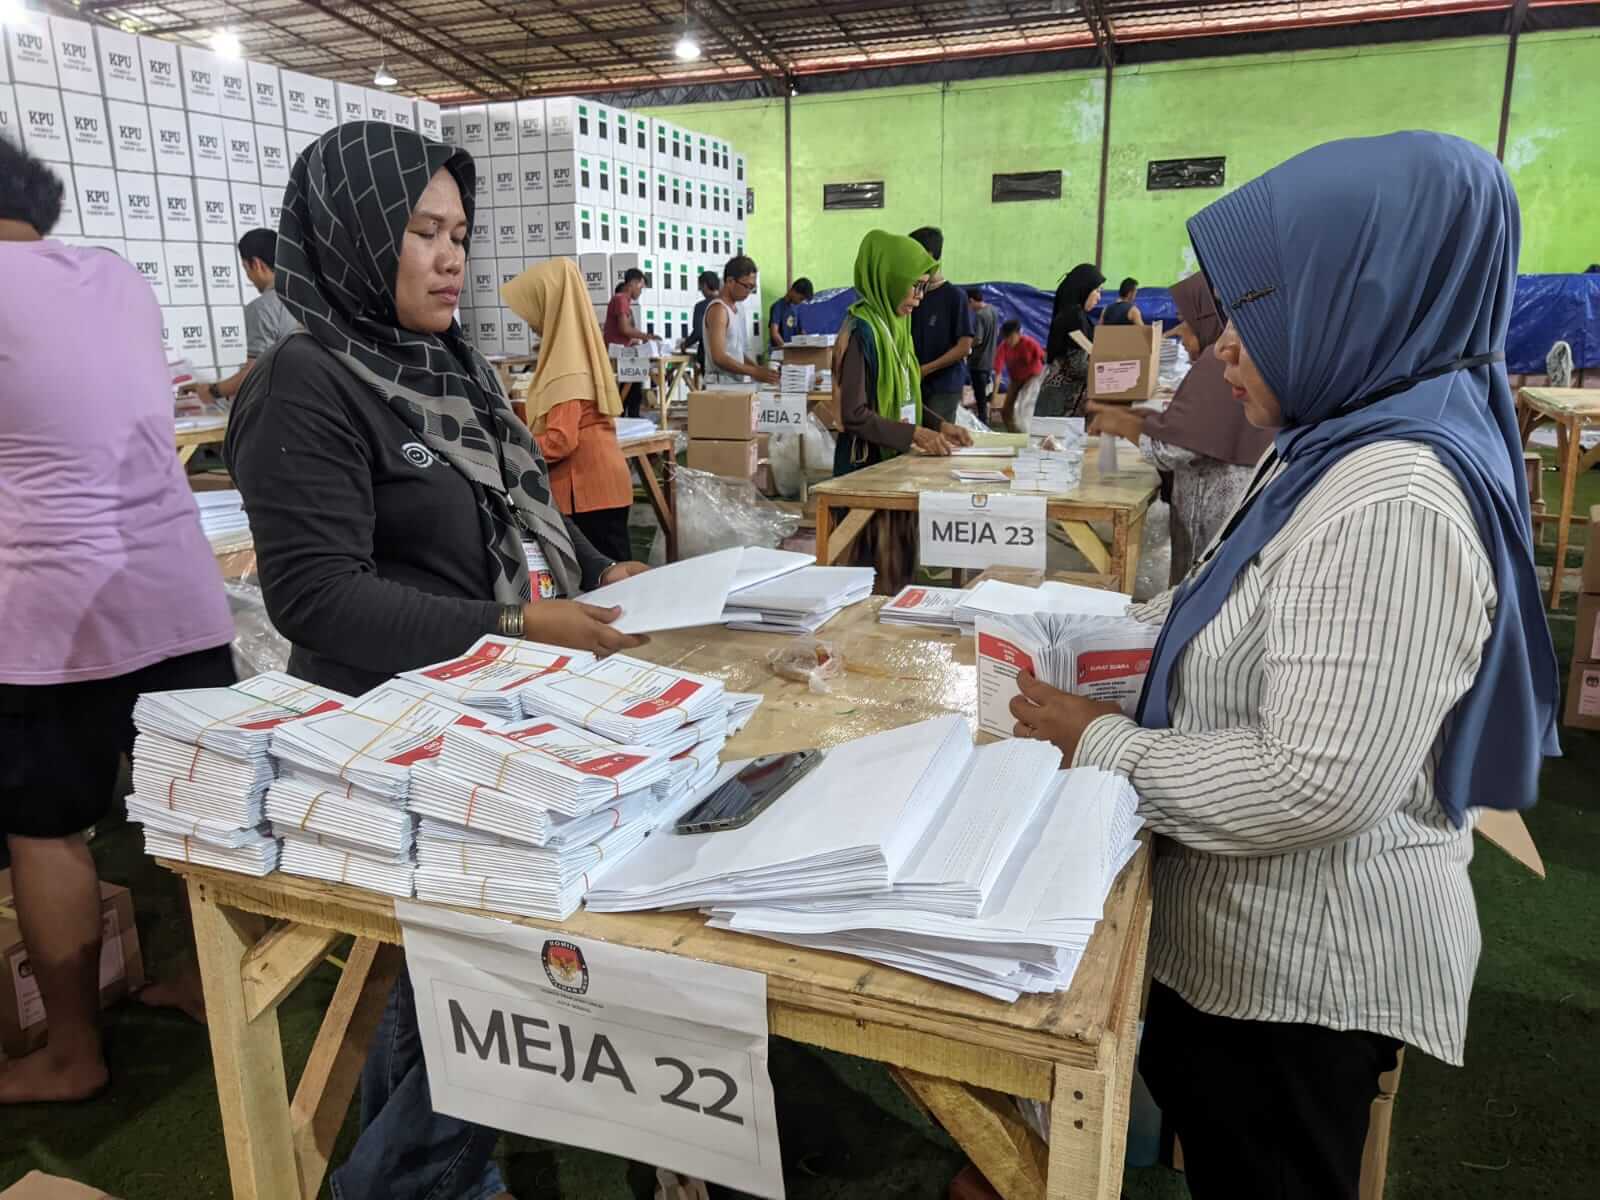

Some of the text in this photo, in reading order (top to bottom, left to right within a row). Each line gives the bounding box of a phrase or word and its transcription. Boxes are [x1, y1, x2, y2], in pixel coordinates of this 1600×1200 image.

[109, 53, 131, 68] KPU
[150, 61, 171, 74] KPU
[191, 71, 210, 84] KPU
[224, 75, 241, 89] KPU
[28, 111, 54, 126] KPU
[75, 116, 98, 131] KPU
[120, 126, 142, 140] KPU
[160, 130, 180, 143] KPU
[198, 135, 218, 148] KPU
[232, 140, 249, 152] KPU
[85, 190, 109, 203] KPU
[128, 195, 150, 207] KPU
[167, 198, 187, 210] KPU
[206, 201, 224, 213] KPU
[239, 204, 256, 215] KPU
[137, 262, 158, 273] KPU
[174, 265, 194, 277] KPU
[212, 266, 231, 278] KPU
[183, 326, 202, 338] KPU
[221, 326, 239, 337] KPU
[793, 412, 801, 424] 2
[931, 519, 1035, 547] MEJA 23
[447, 998, 745, 1126] MEJA 22
